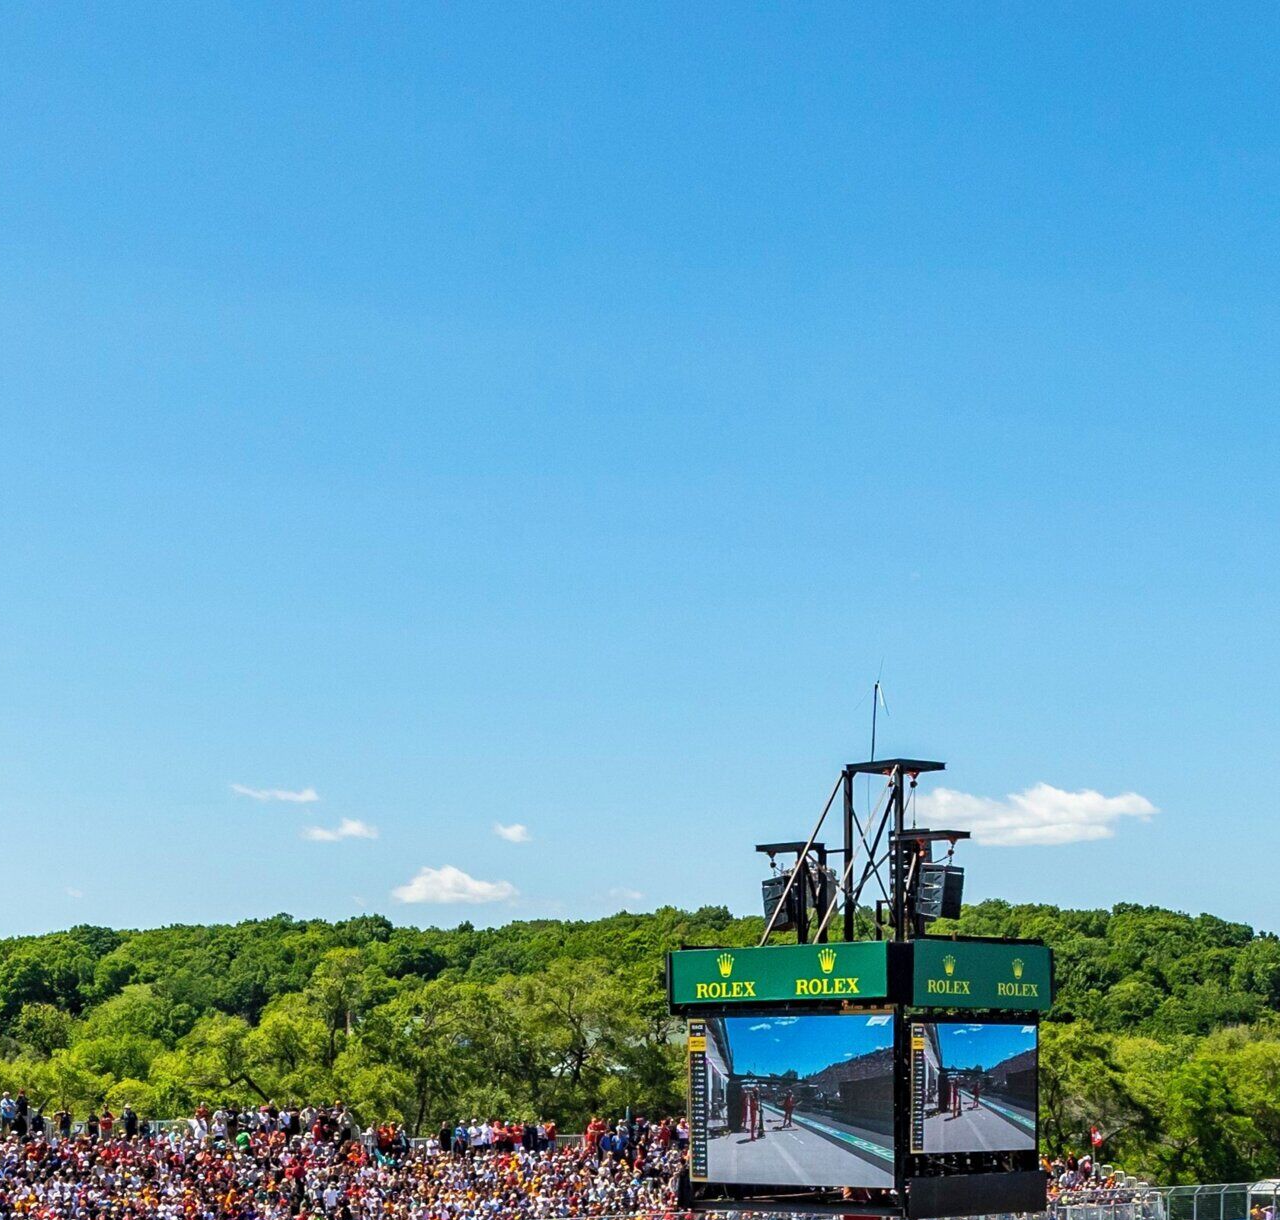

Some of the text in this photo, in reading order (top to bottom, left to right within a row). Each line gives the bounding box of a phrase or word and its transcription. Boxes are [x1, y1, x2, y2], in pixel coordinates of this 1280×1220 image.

[697, 982, 755, 998] ROLEX
[797, 978, 858, 994] ROLEX
[928, 980, 969, 994] ROLEX
[998, 983, 1037, 996] ROLEX
